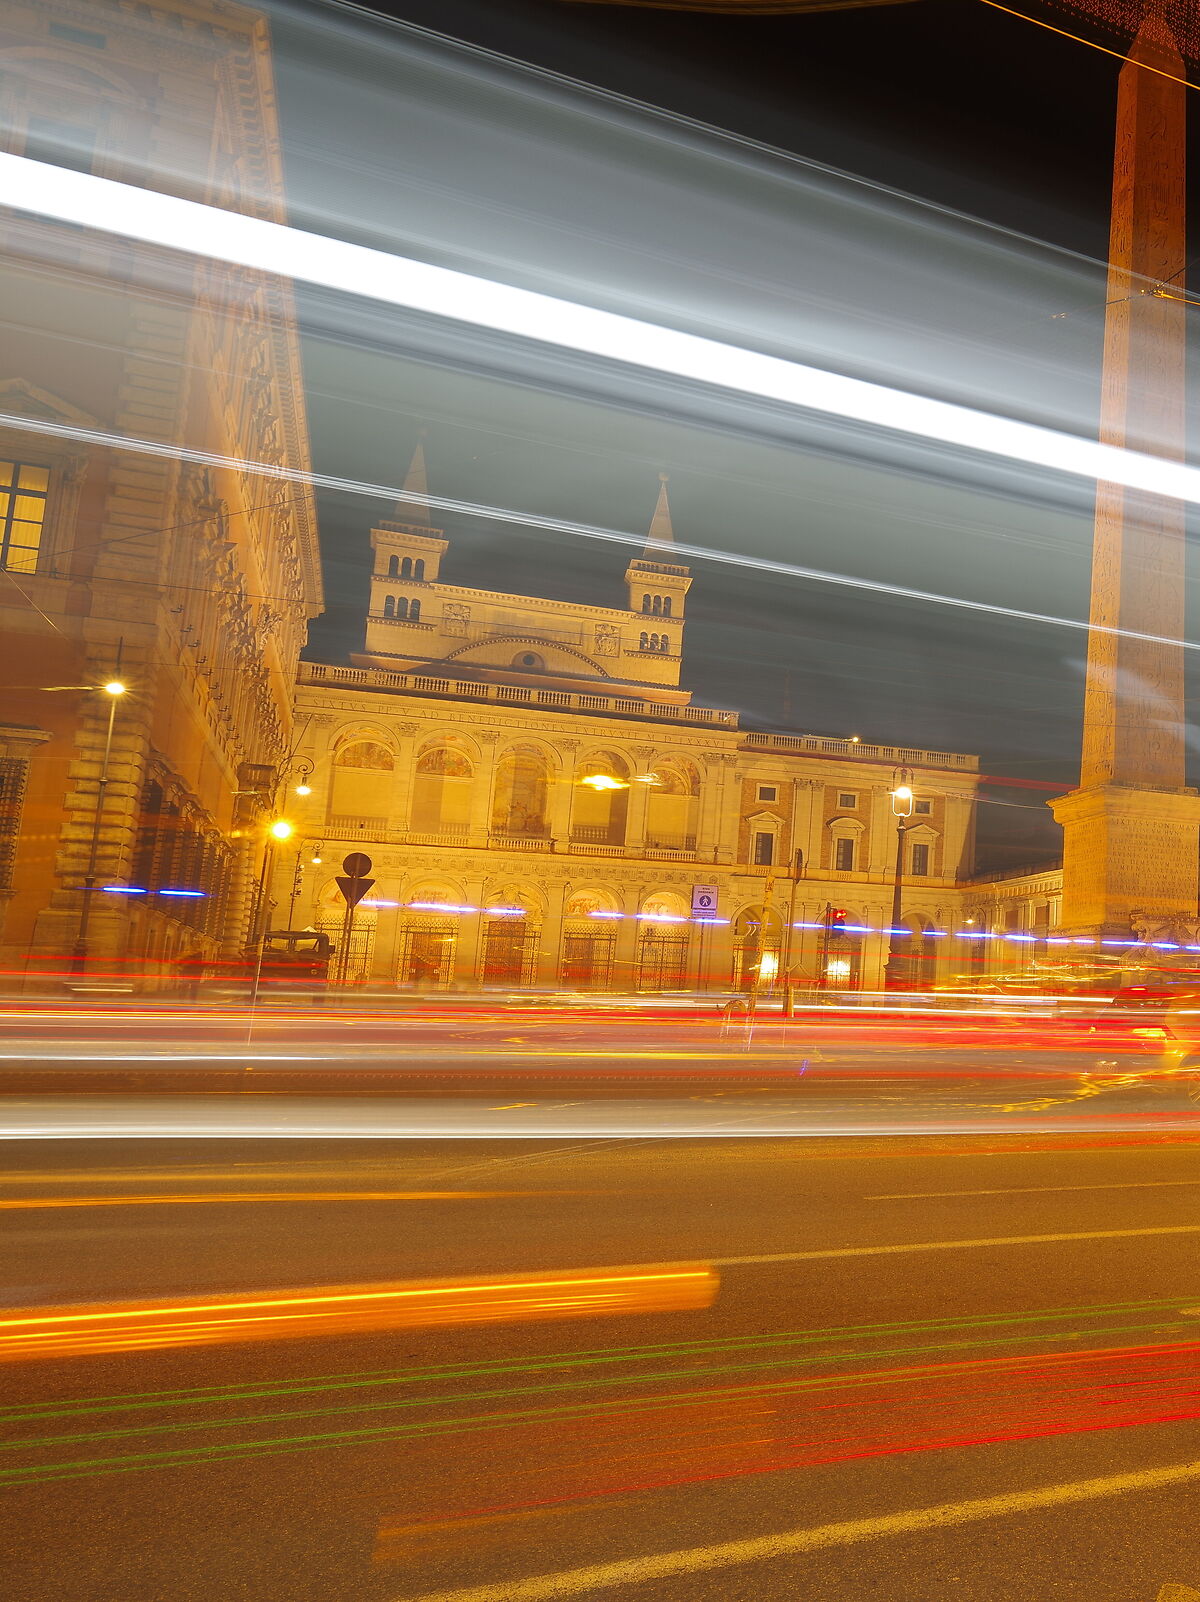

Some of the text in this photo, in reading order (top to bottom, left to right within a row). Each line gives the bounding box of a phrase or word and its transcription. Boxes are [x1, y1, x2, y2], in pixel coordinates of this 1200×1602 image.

[313, 699, 366, 711] SIXTVS
[422, 710, 439, 719] AD
[450, 712, 565, 732] BENEDICTIONES
